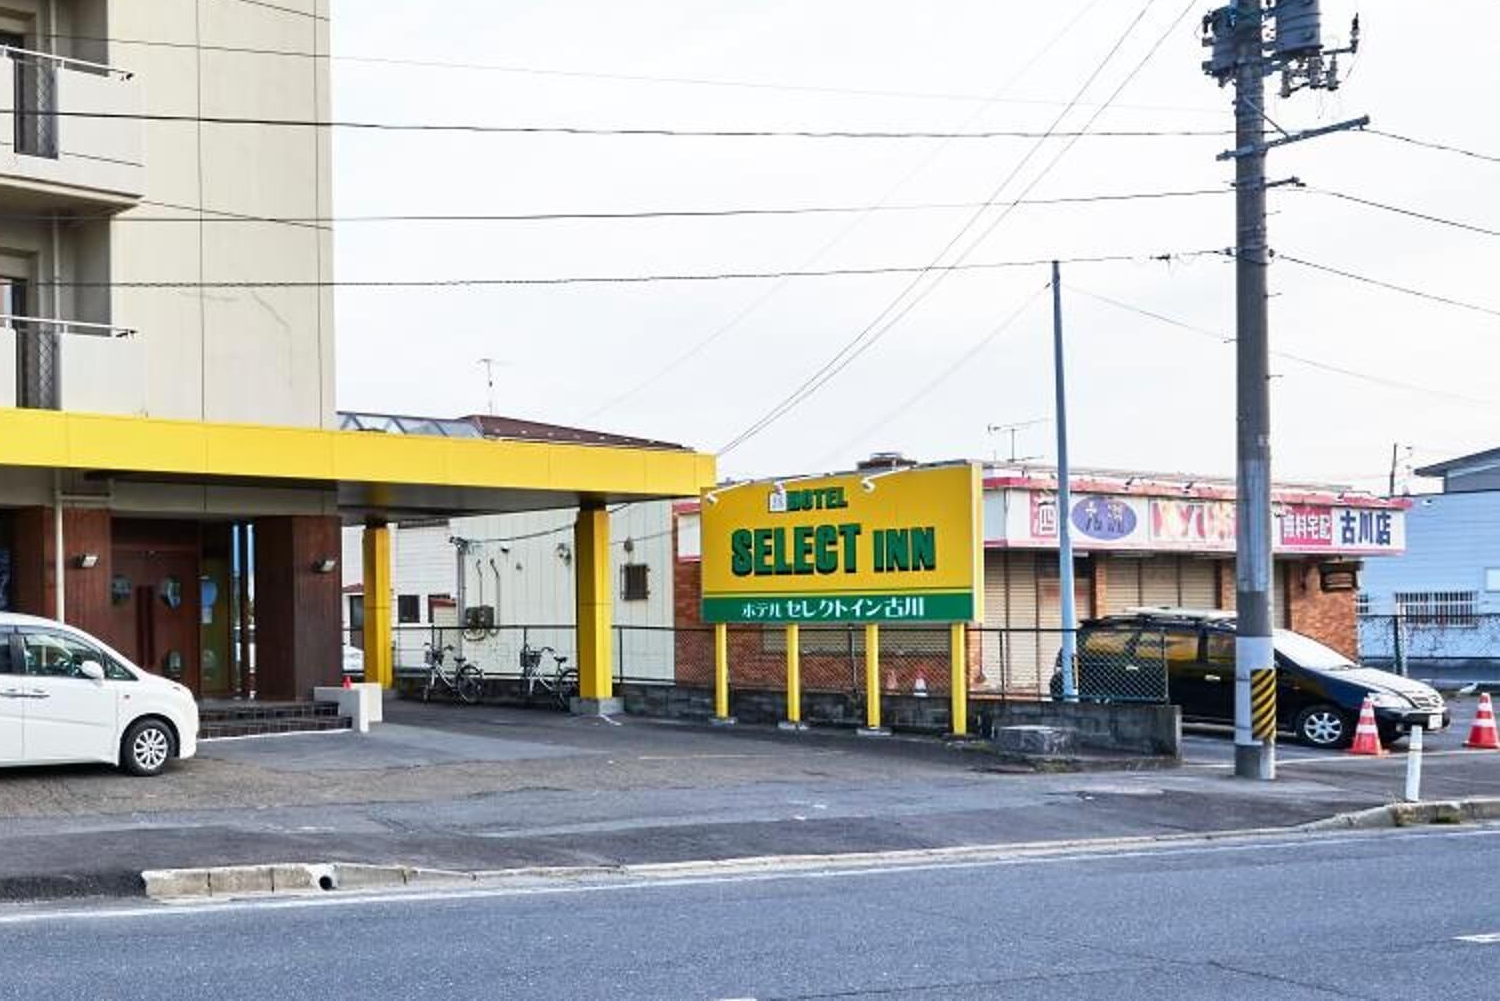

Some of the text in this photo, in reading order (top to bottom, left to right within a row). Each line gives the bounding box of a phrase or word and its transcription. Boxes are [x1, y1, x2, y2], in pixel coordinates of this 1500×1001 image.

[1340, 509, 1392, 546] 古川店
[731, 523, 936, 577] SELECT INN
[741, 596, 924, 618] ホテル セレクトイン古川
